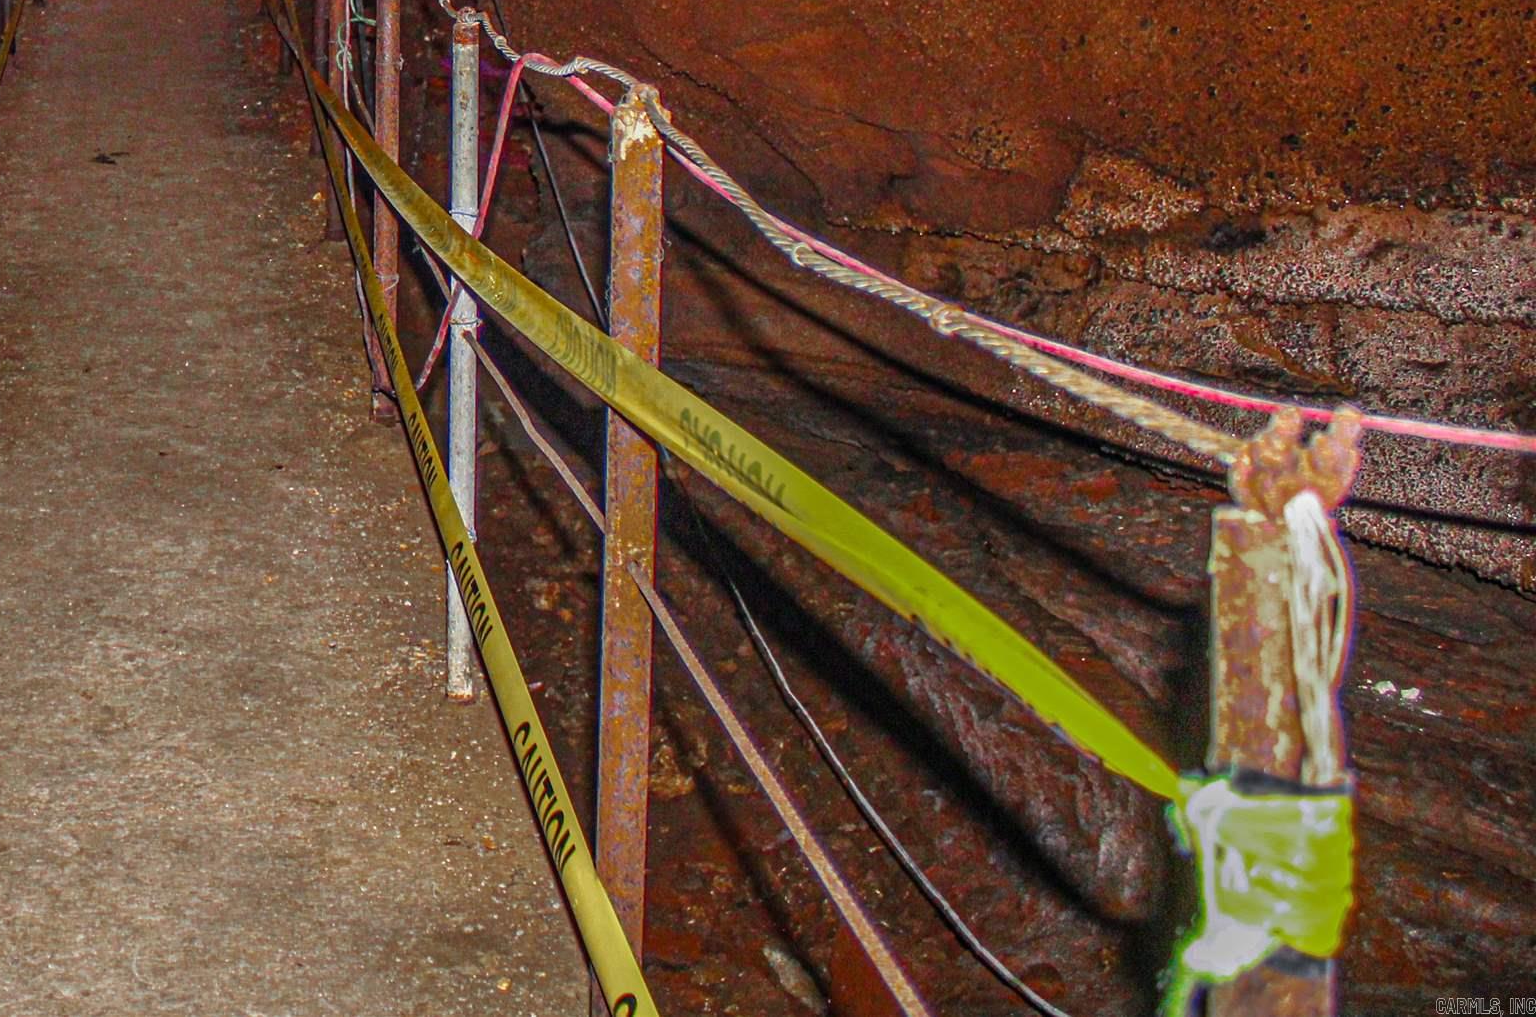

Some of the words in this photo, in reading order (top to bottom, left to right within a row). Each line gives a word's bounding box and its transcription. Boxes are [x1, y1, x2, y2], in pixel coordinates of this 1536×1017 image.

[407, 411, 438, 489] CAUTION
[451, 541, 492, 645] CAUTION
[512, 721, 576, 873] CAUTION
